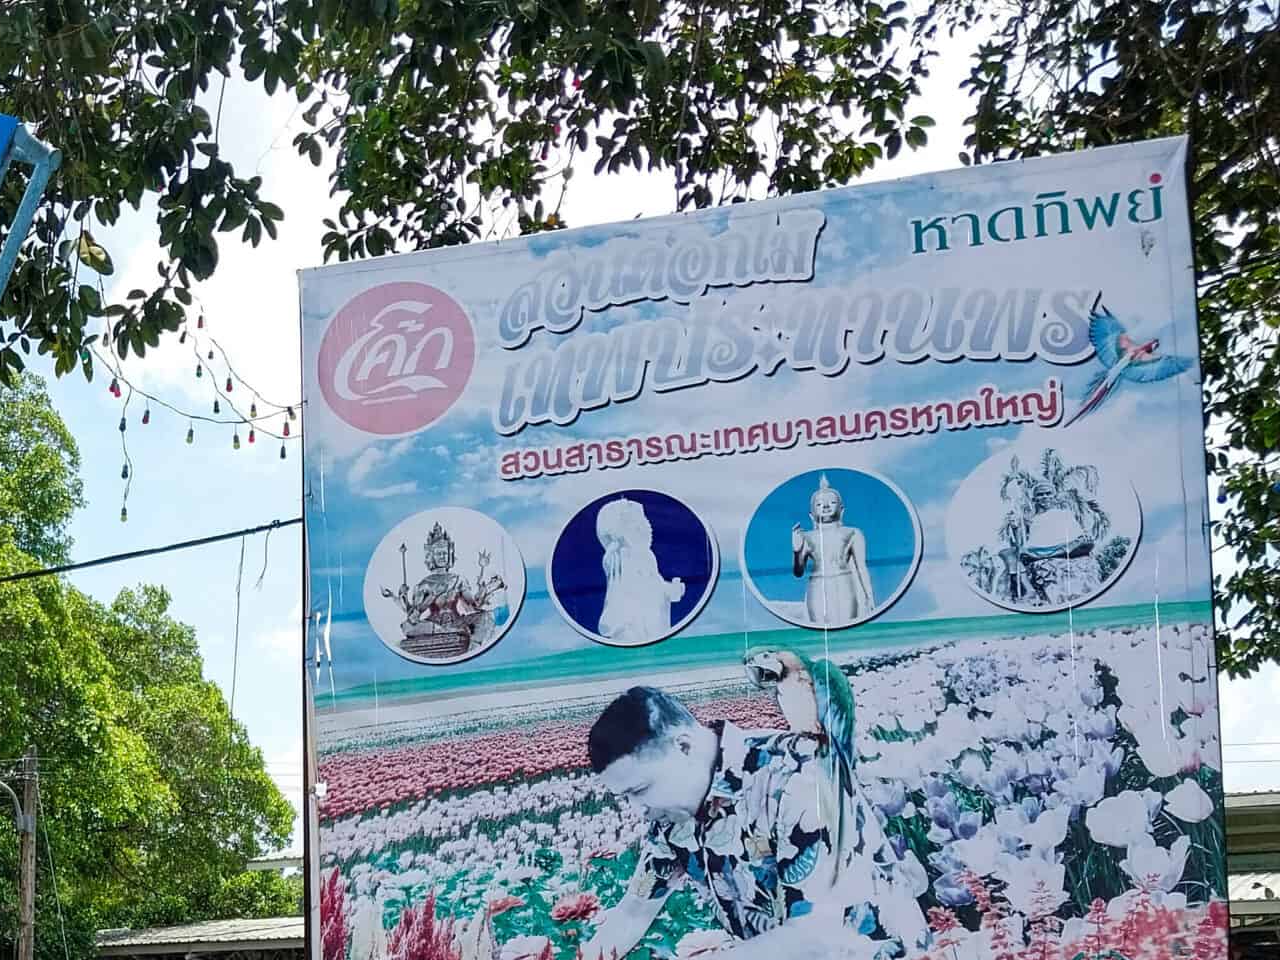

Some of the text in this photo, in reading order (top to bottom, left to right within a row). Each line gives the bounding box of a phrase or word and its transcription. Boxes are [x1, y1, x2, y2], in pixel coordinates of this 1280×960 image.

[500, 377, 1060, 480] สวนสาธารณะเทศบาลนครหาดใหญ่
